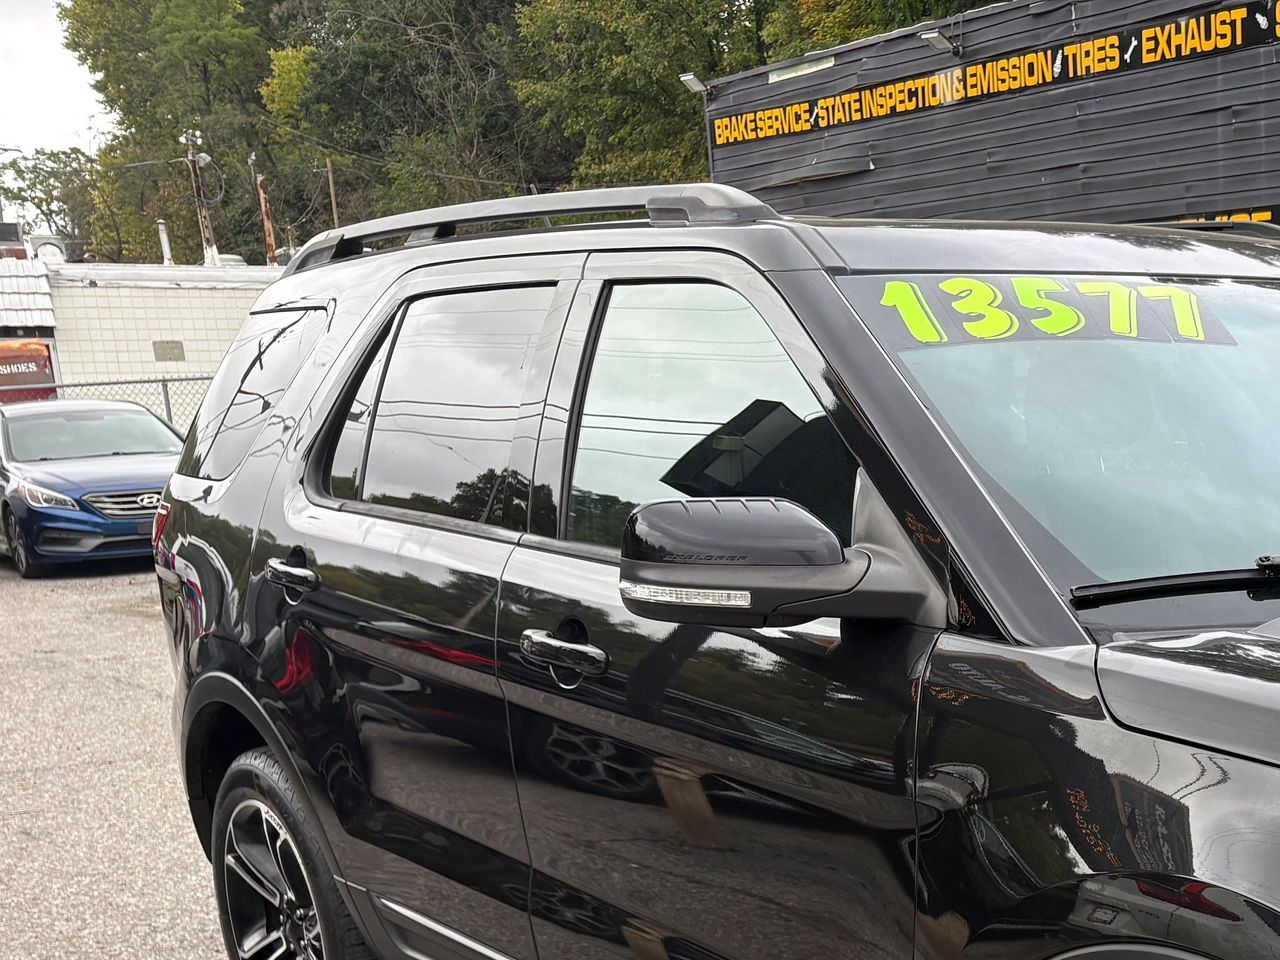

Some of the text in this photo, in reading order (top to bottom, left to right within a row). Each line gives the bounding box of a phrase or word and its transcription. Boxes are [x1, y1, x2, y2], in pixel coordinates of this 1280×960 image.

[1064, 35, 1120, 77] TIRES
[1141, 8, 1247, 63] EXHAUST
[817, 50, 1053, 127] STATE INSPECTION & EMISSION
[714, 103, 811, 145] BRAKE SERVICE
[880, 277, 1205, 344] 13577
[0, 362, 37, 375] SHOES
